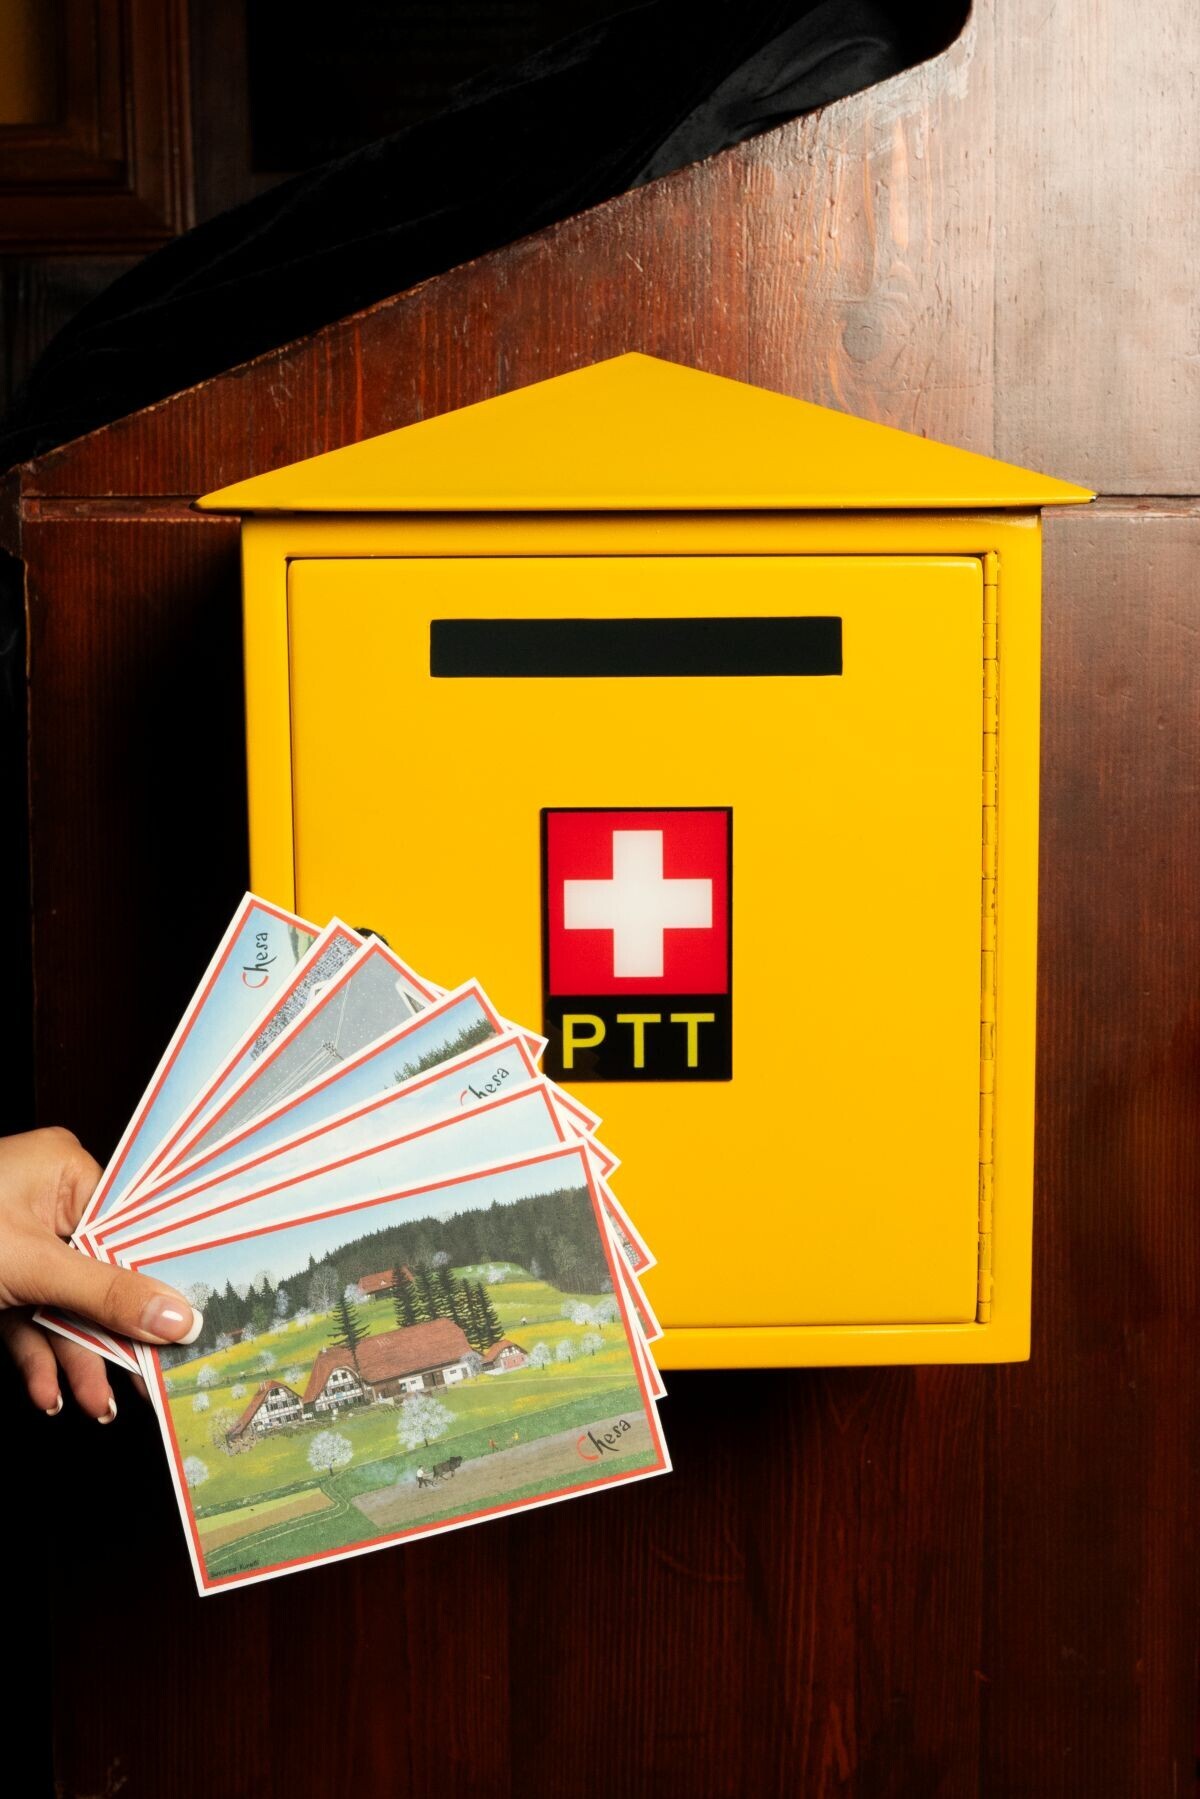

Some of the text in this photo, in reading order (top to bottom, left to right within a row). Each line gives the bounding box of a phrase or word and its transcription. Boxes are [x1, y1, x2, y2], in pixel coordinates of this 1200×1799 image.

[242, 932, 278, 989] Chesa
[562, 1013, 716, 1069] PTT
[576, 1419, 632, 1461] Chesa
